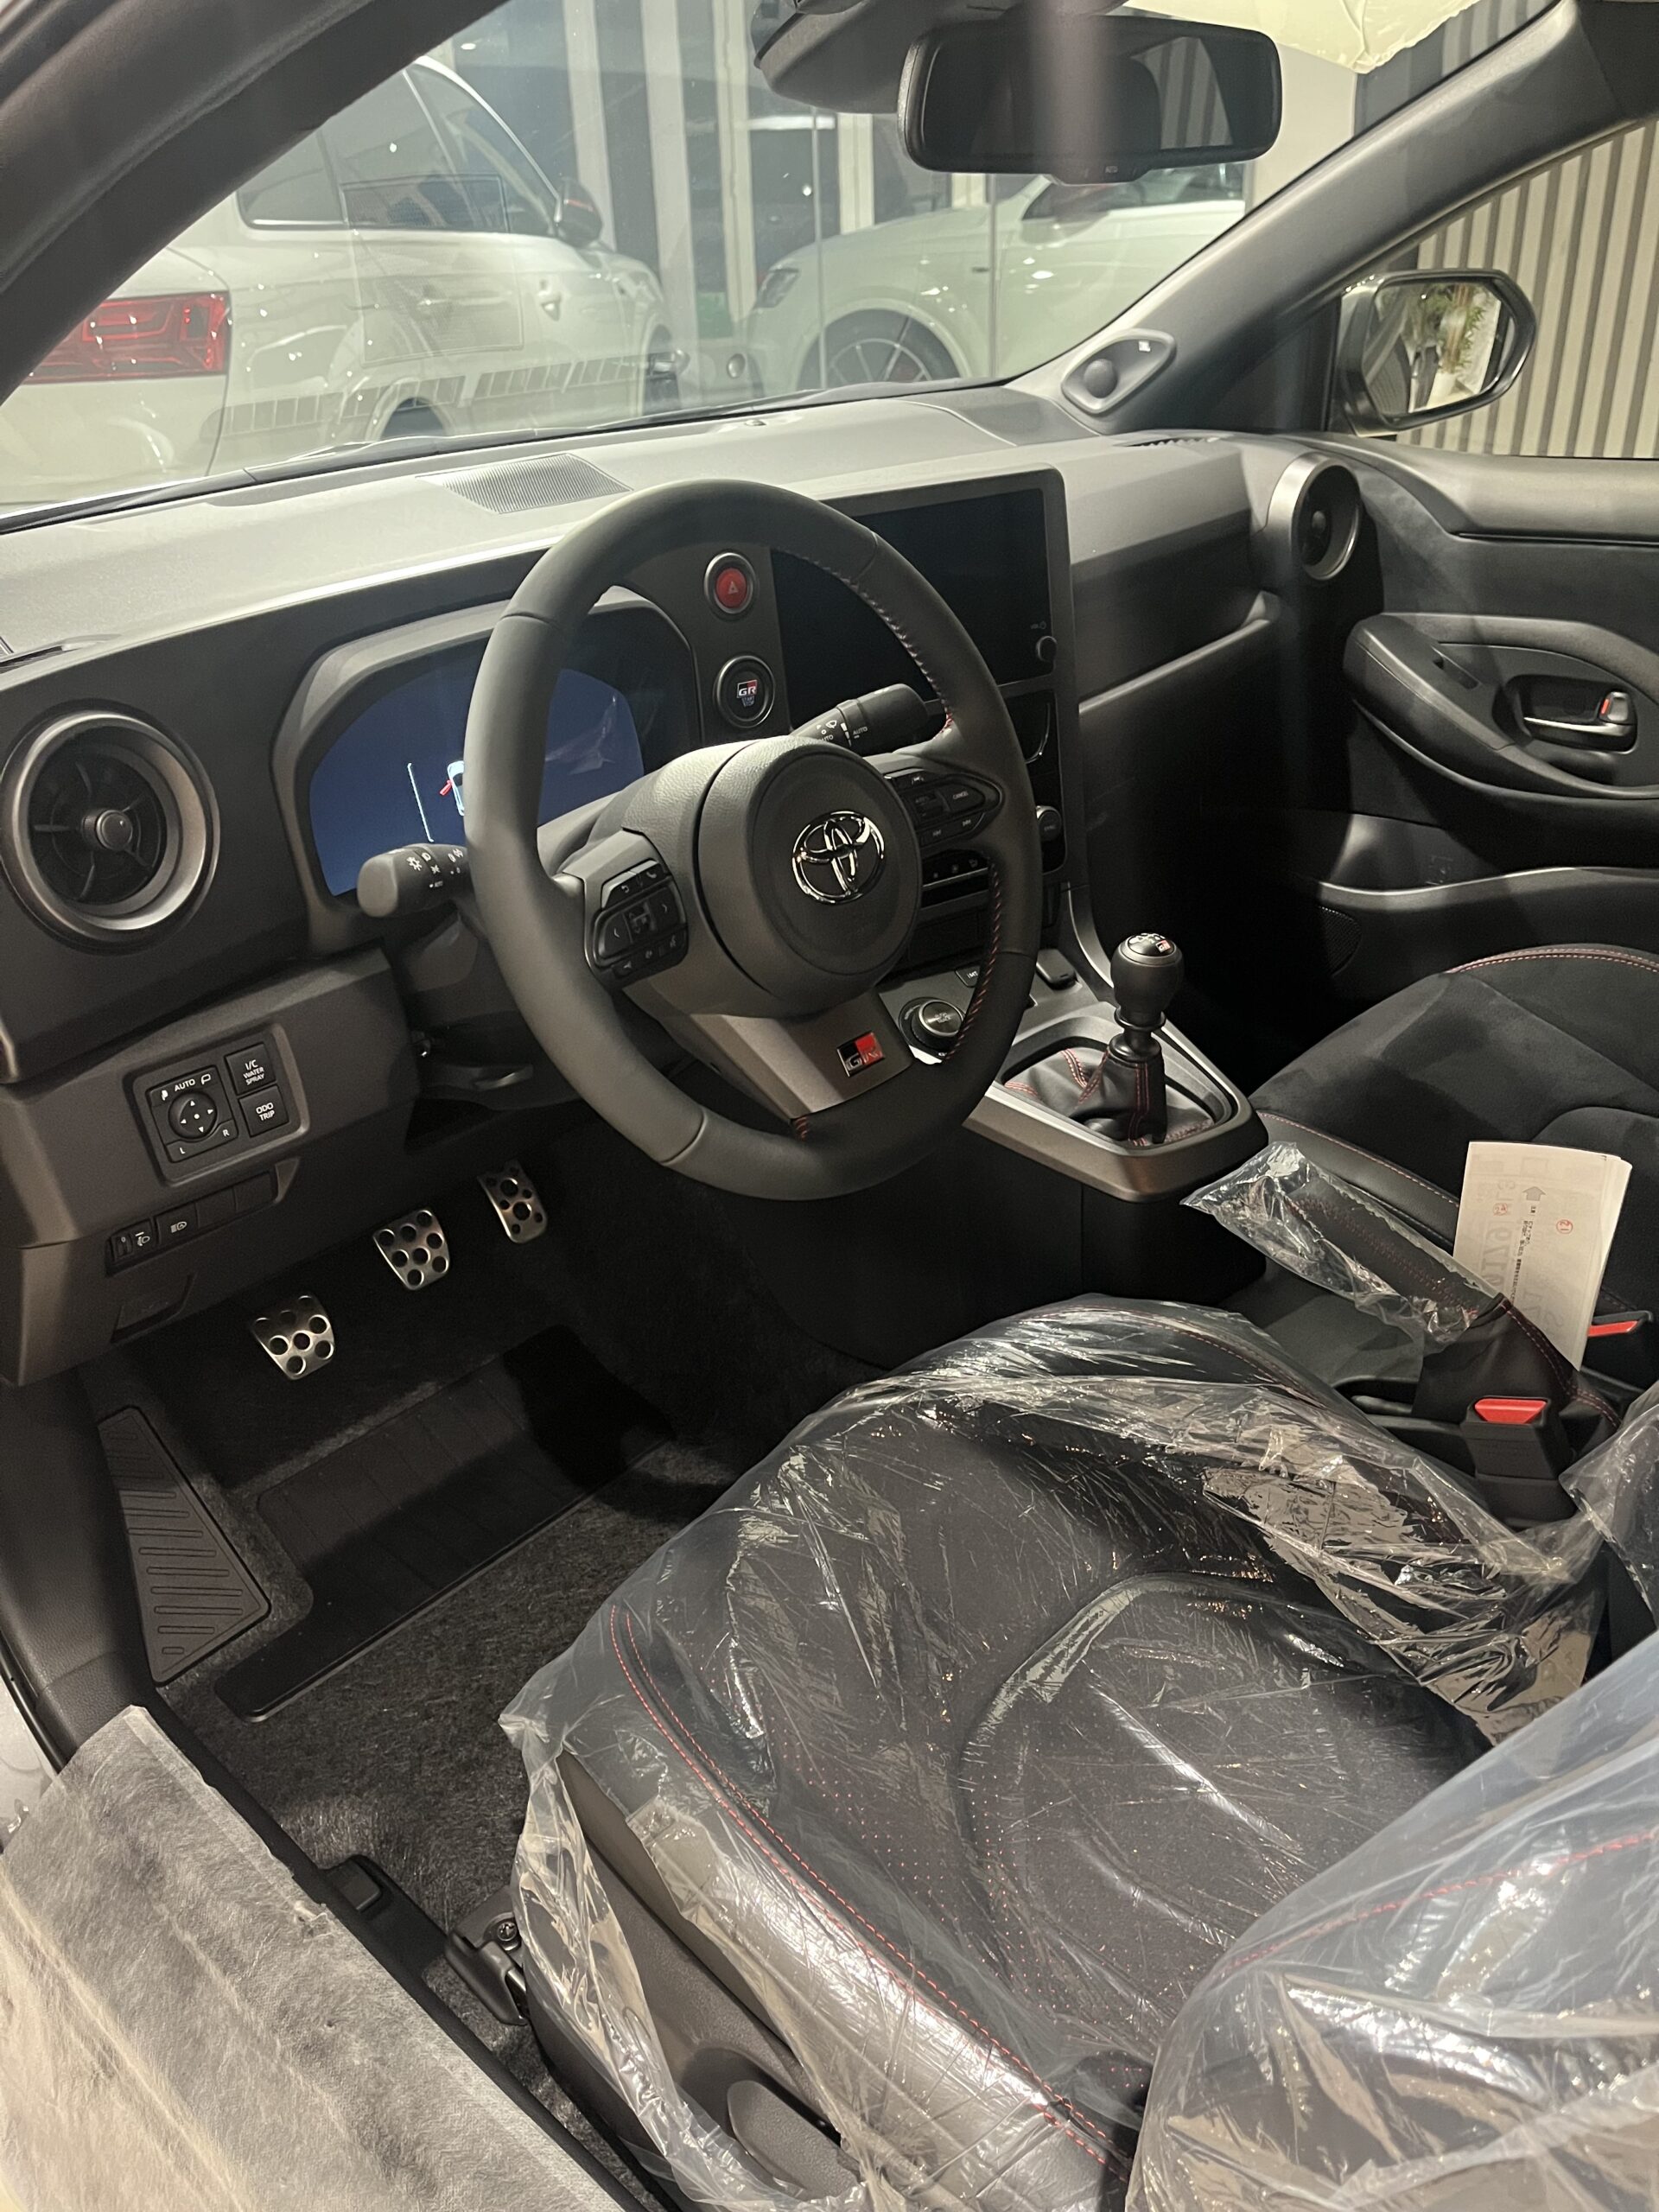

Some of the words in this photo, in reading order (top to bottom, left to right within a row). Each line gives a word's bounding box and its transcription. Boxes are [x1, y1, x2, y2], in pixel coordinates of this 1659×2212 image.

[738, 686, 757, 696] GR
[853, 726, 868, 735] AUTO
[822, 734, 834, 742] UTO
[245, 1059, 258, 1071] I/C
[243, 1066, 264, 1079] WATER
[174, 1078, 196, 1092] AUTO
[245, 1073, 264, 1085] SPRAY
[256, 1102, 274, 1115] ODO
[259, 1109, 275, 1121] TRIP
[222, 1128, 230, 1137] R
